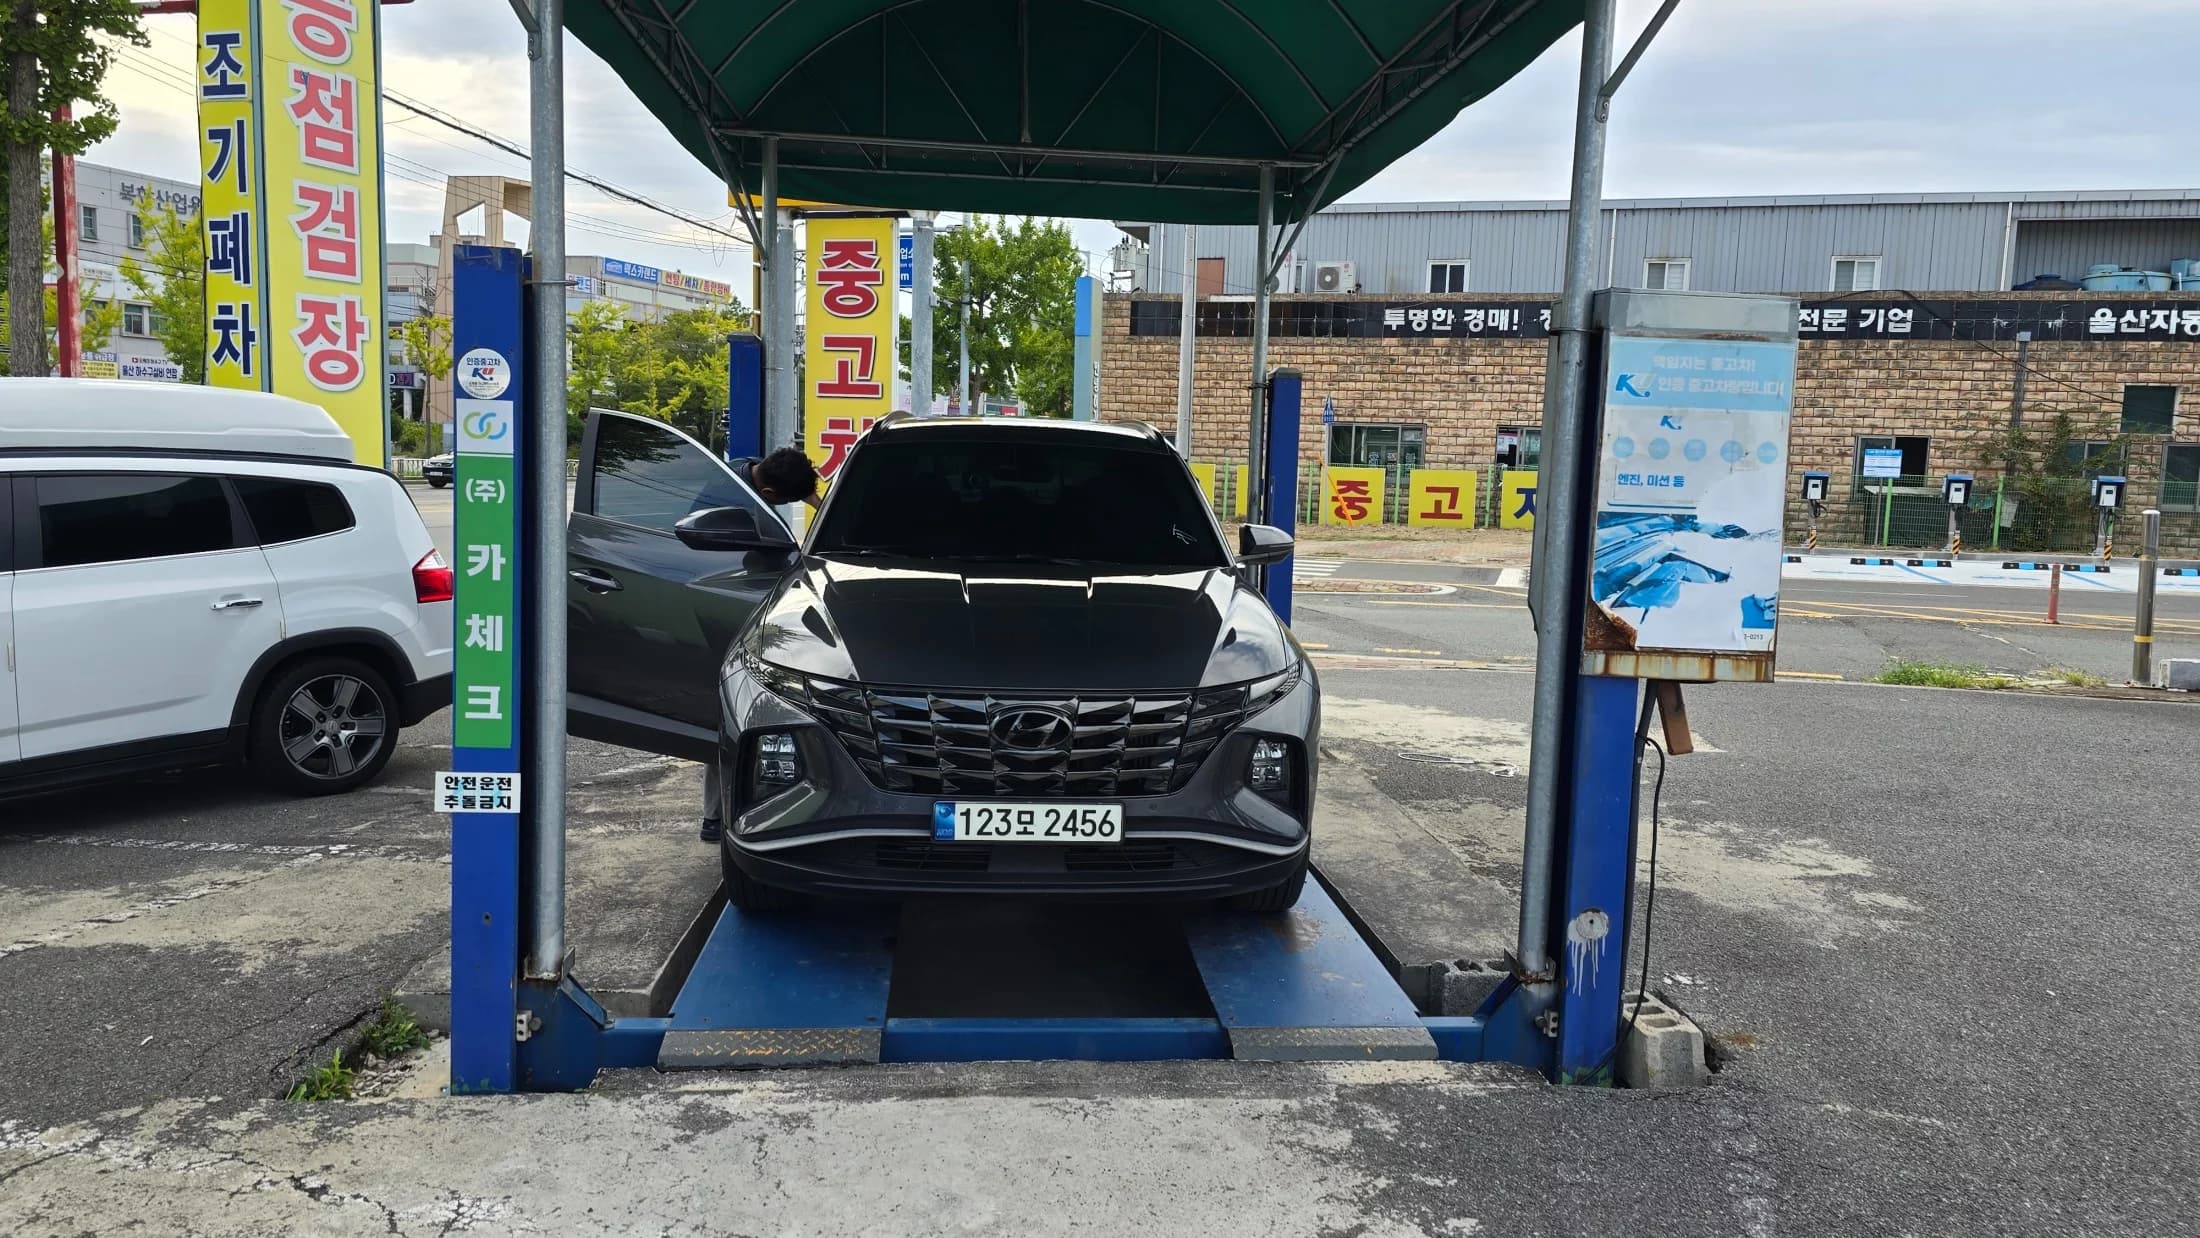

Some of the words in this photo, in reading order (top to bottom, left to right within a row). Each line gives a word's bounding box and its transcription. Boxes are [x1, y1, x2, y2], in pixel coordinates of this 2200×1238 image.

[202, 31, 256, 376] 조기폐차
[1383, 308, 1455, 332] 투명한
[1463, 308, 1519, 332] 경매!
[1798, 308, 1848, 332] 전문
[1859, 307, 1914, 333] 기업
[466, 357, 501, 367] 인증중고차
[464, 478, 506, 504] (주)
[1673, 475, 1685, 488] 등
[464, 543, 506, 720] 카체크
[444, 775, 512, 791] 안전운전
[444, 795, 512, 810] 추돌금지
[959, 807, 1035, 837] 123모
[1044, 807, 1115, 837] 2456
